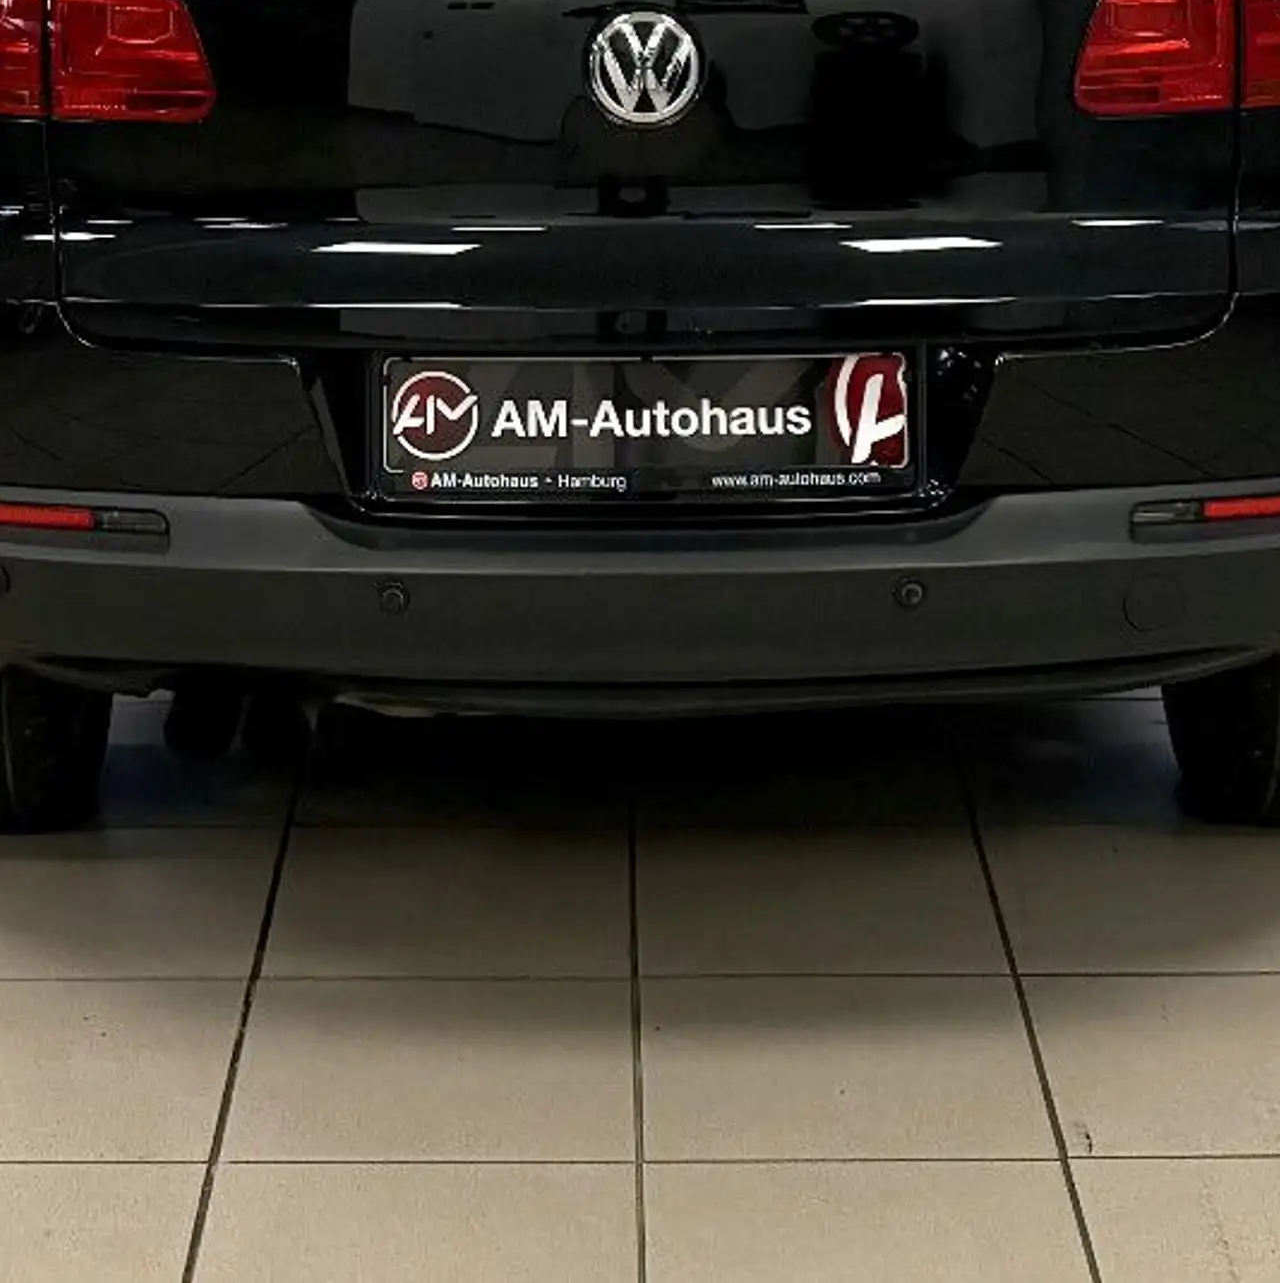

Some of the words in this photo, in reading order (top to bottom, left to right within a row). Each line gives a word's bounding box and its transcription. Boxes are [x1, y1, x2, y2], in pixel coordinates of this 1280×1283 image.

[491, 398, 812, 437] AM-Autohaus
[431, 473, 539, 488] AM-Autohaus
[558, 474, 627, 492] Hamburg
[711, 472, 882, 488] www.am-autohaus.com
